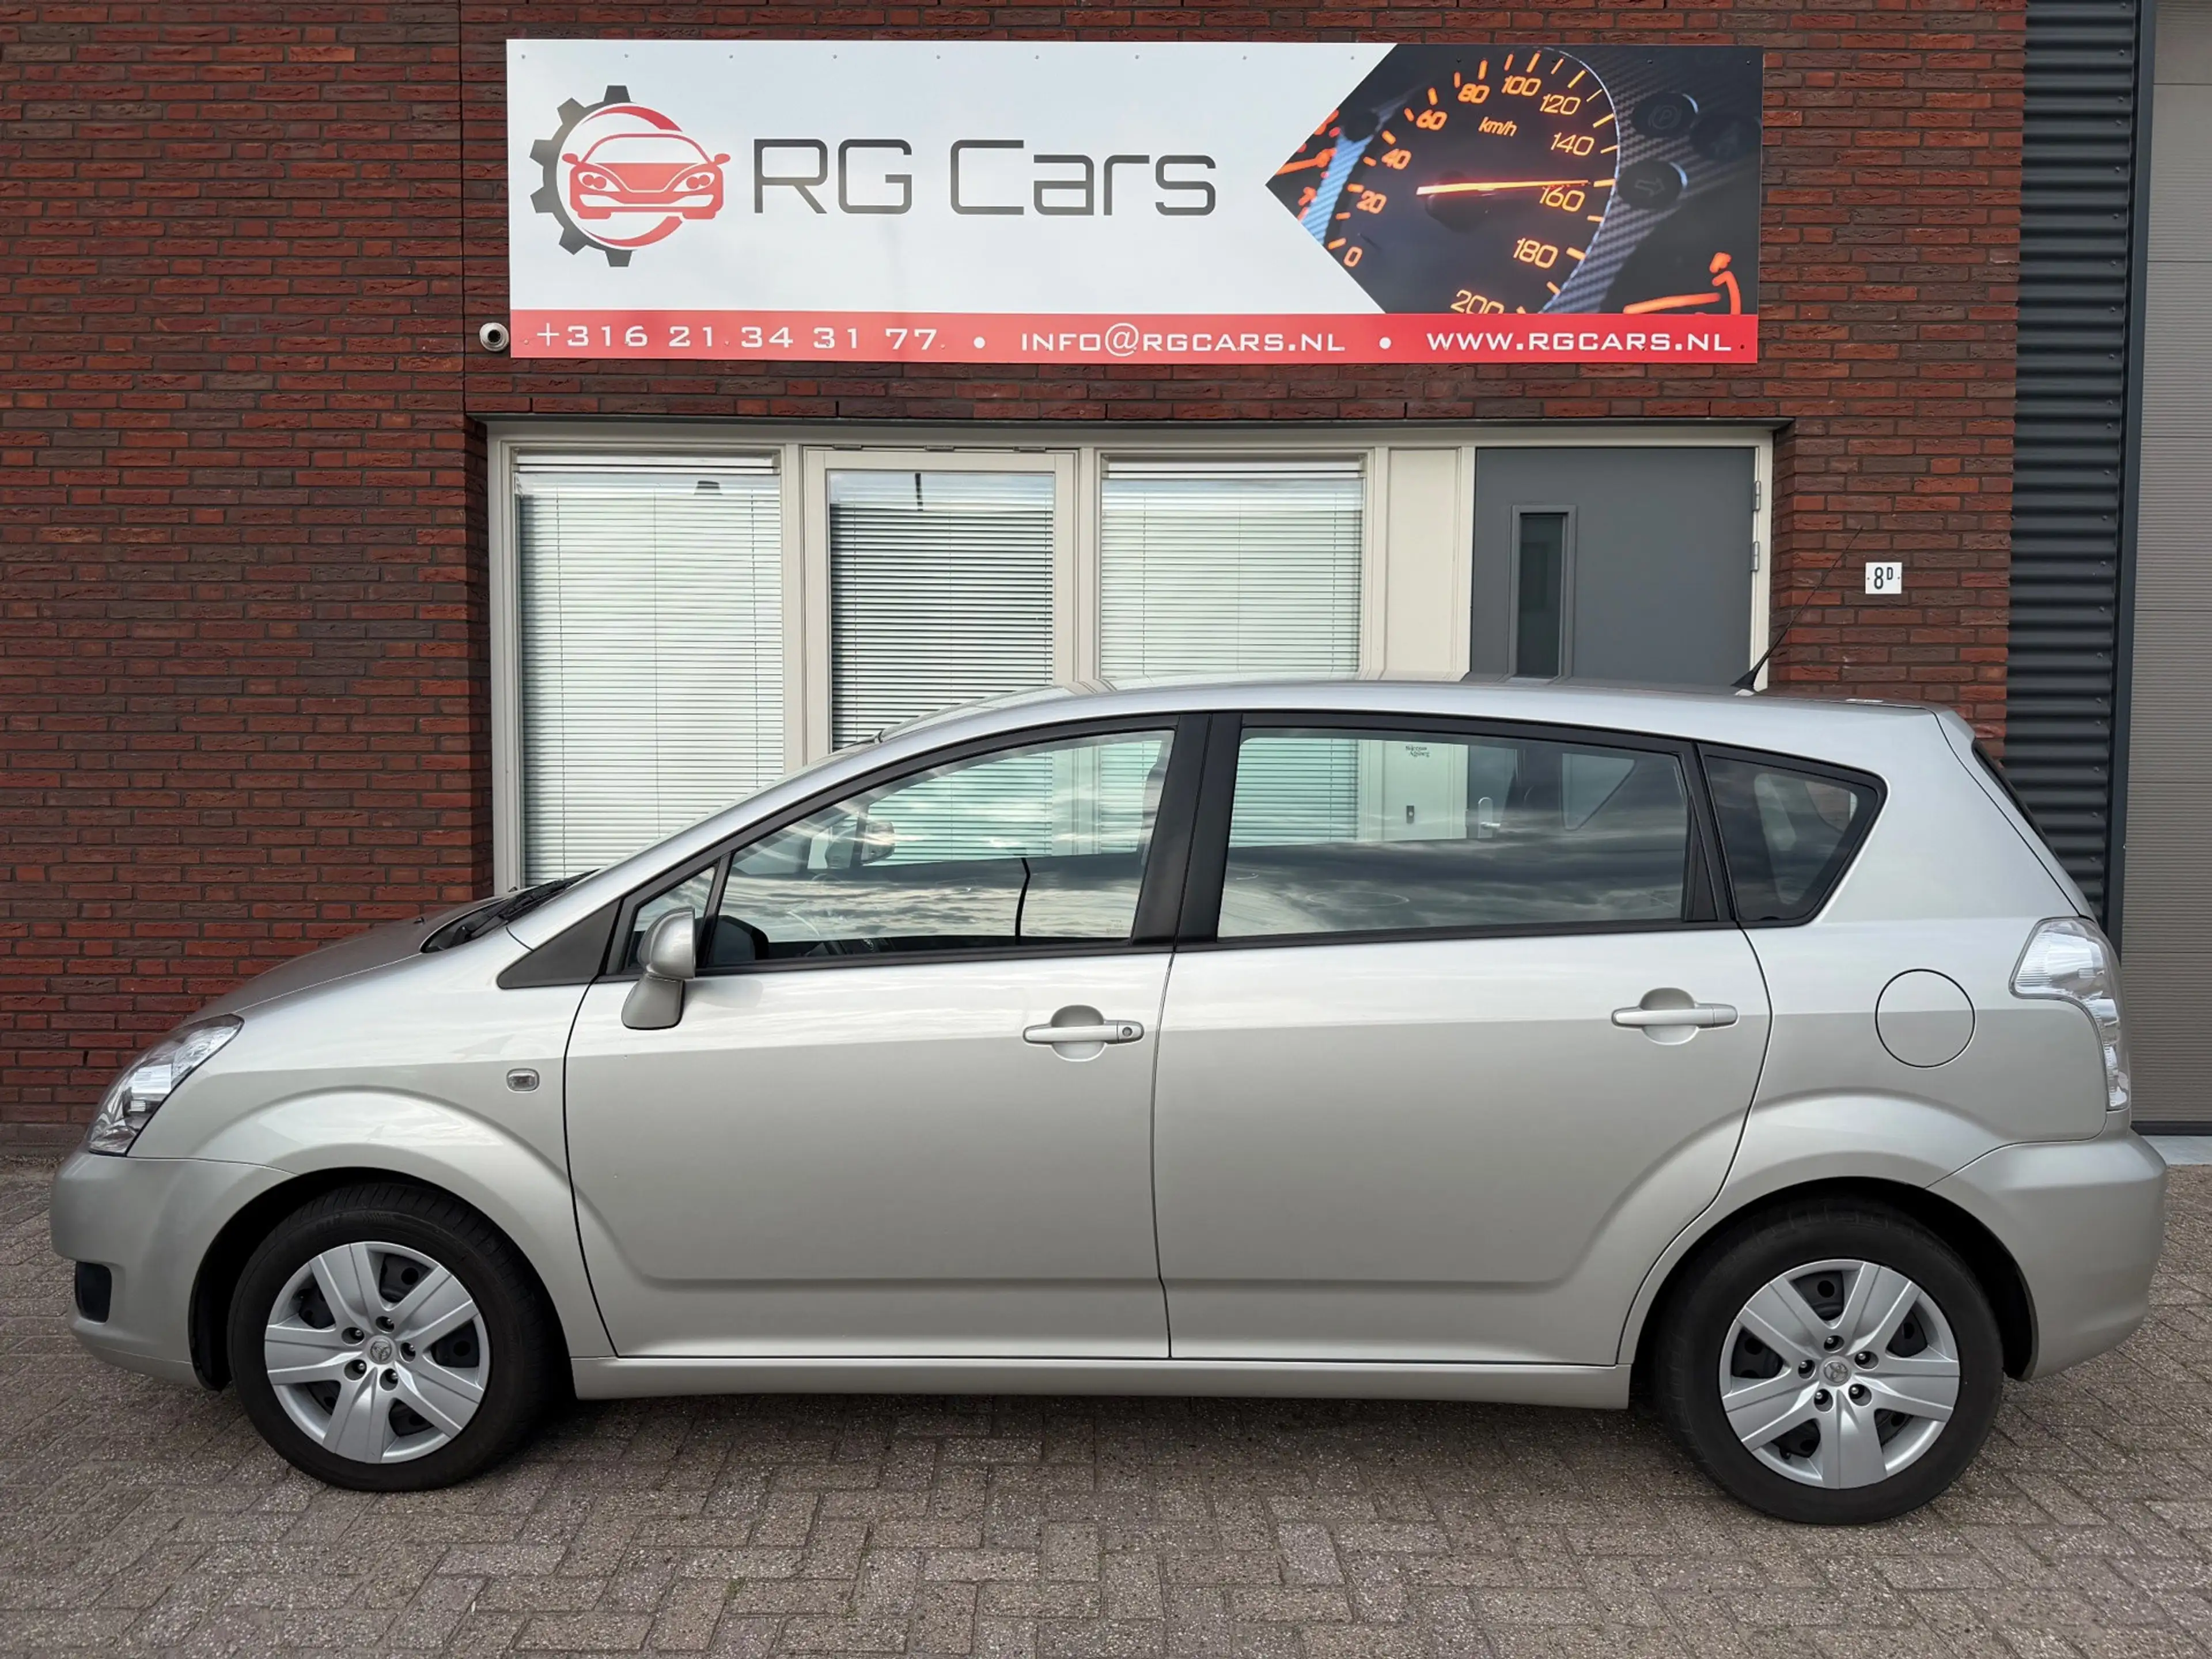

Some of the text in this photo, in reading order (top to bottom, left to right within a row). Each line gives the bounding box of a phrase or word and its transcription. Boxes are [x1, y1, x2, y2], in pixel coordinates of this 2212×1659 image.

[1458, 83, 1490, 104] 80
[1501, 75, 1541, 97] 100
[1539, 94, 1581, 115] 120
[1416, 109, 1448, 130] 60
[1478, 116, 1517, 137] km/h
[1551, 132, 1594, 156] 140
[1381, 148, 1412, 169] 40
[753, 138, 1216, 215] RG Cars
[1356, 190, 1387, 214] 20
[1539, 185, 1585, 212] 160
[1343, 246, 1363, 267] 0
[1513, 237, 1558, 269] 180
[536, 323, 938, 350] +316 21 34 31 77
[1021, 323, 1346, 357] INFO@RGCARS.NL
[1426, 332, 1732, 352] WWW.RGCARS.NL
